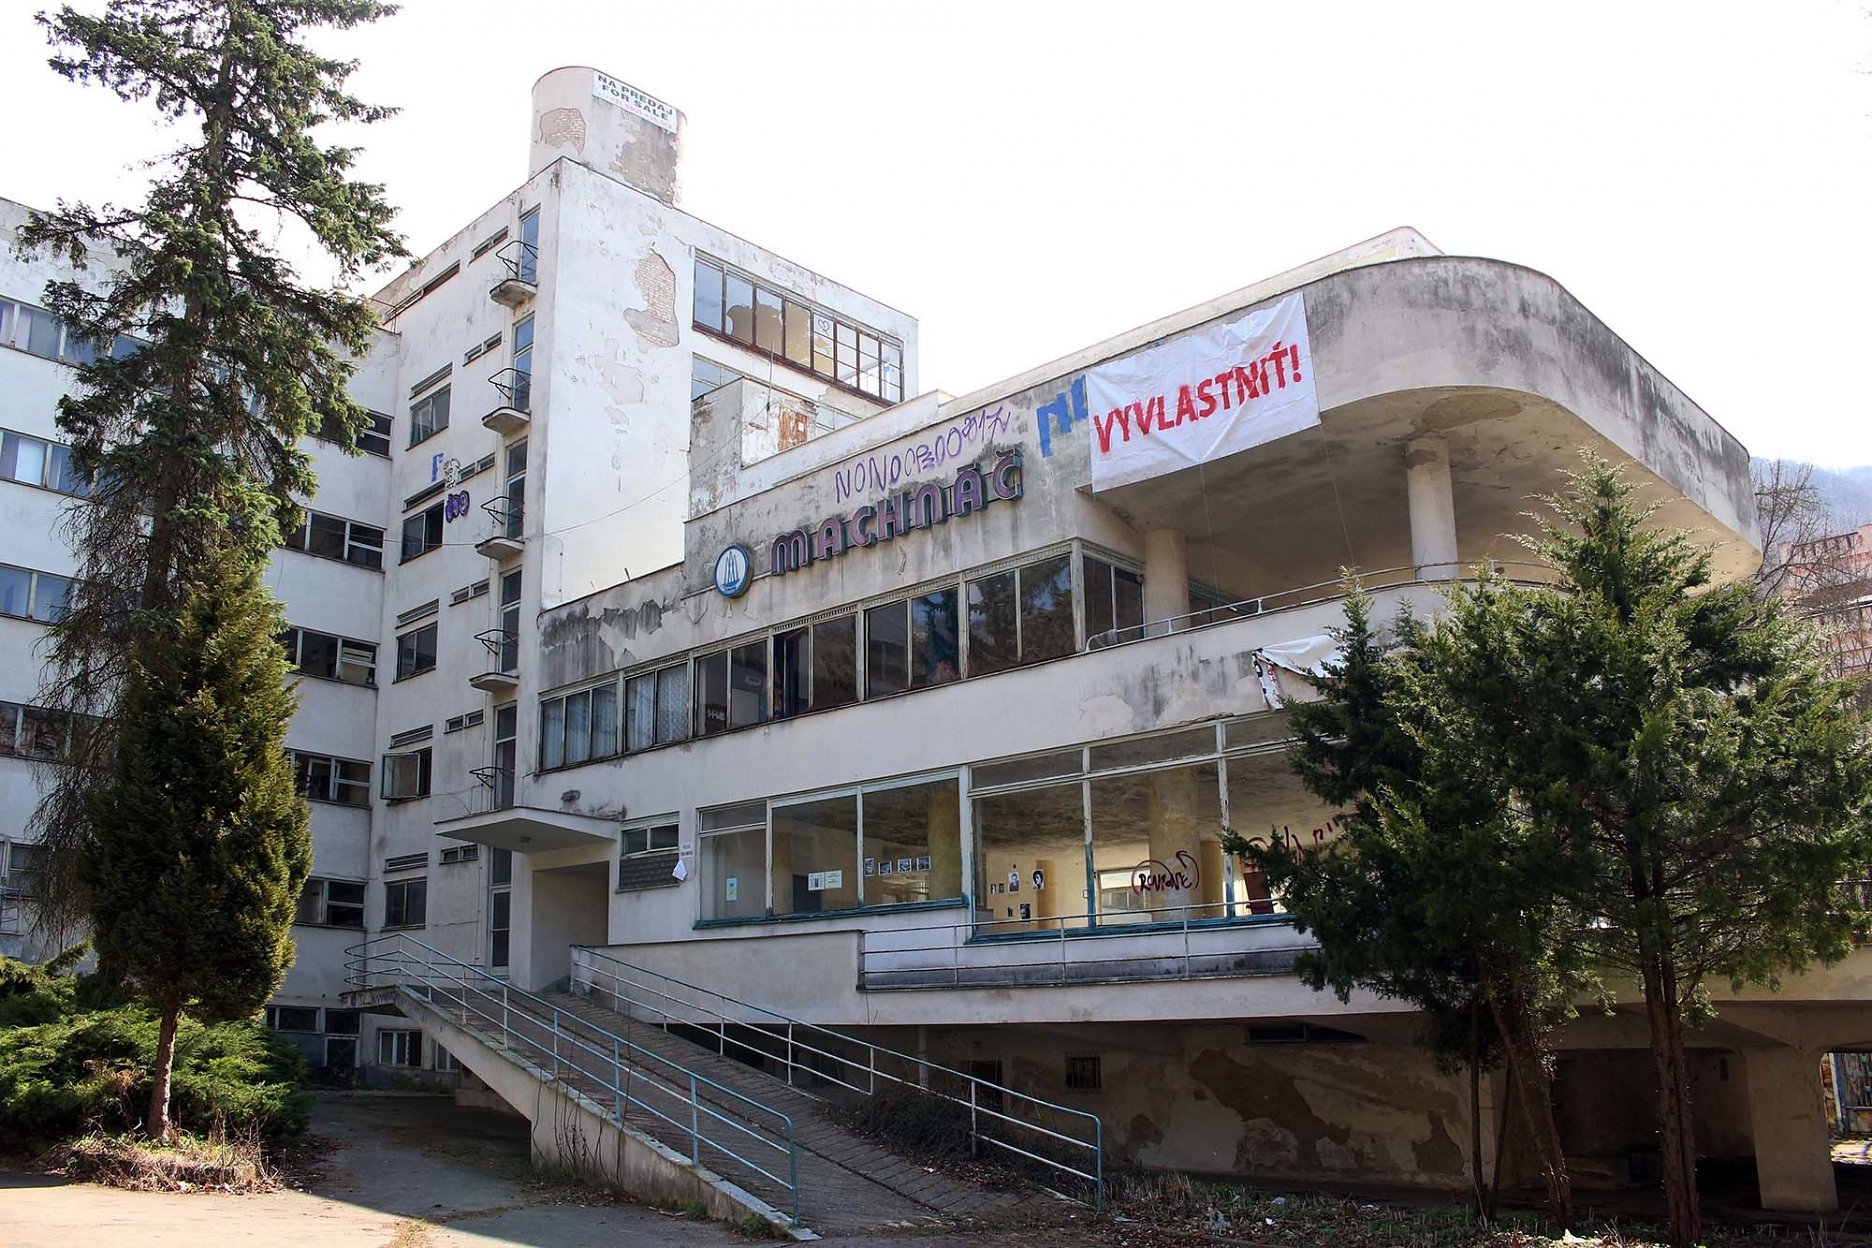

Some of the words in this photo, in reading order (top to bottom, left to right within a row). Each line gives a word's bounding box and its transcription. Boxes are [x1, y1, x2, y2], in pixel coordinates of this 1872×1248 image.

[598, 74, 617, 89] NA
[621, 85, 674, 116] PREDAJ
[602, 84, 630, 103] FOR
[634, 100, 670, 121] SALE
